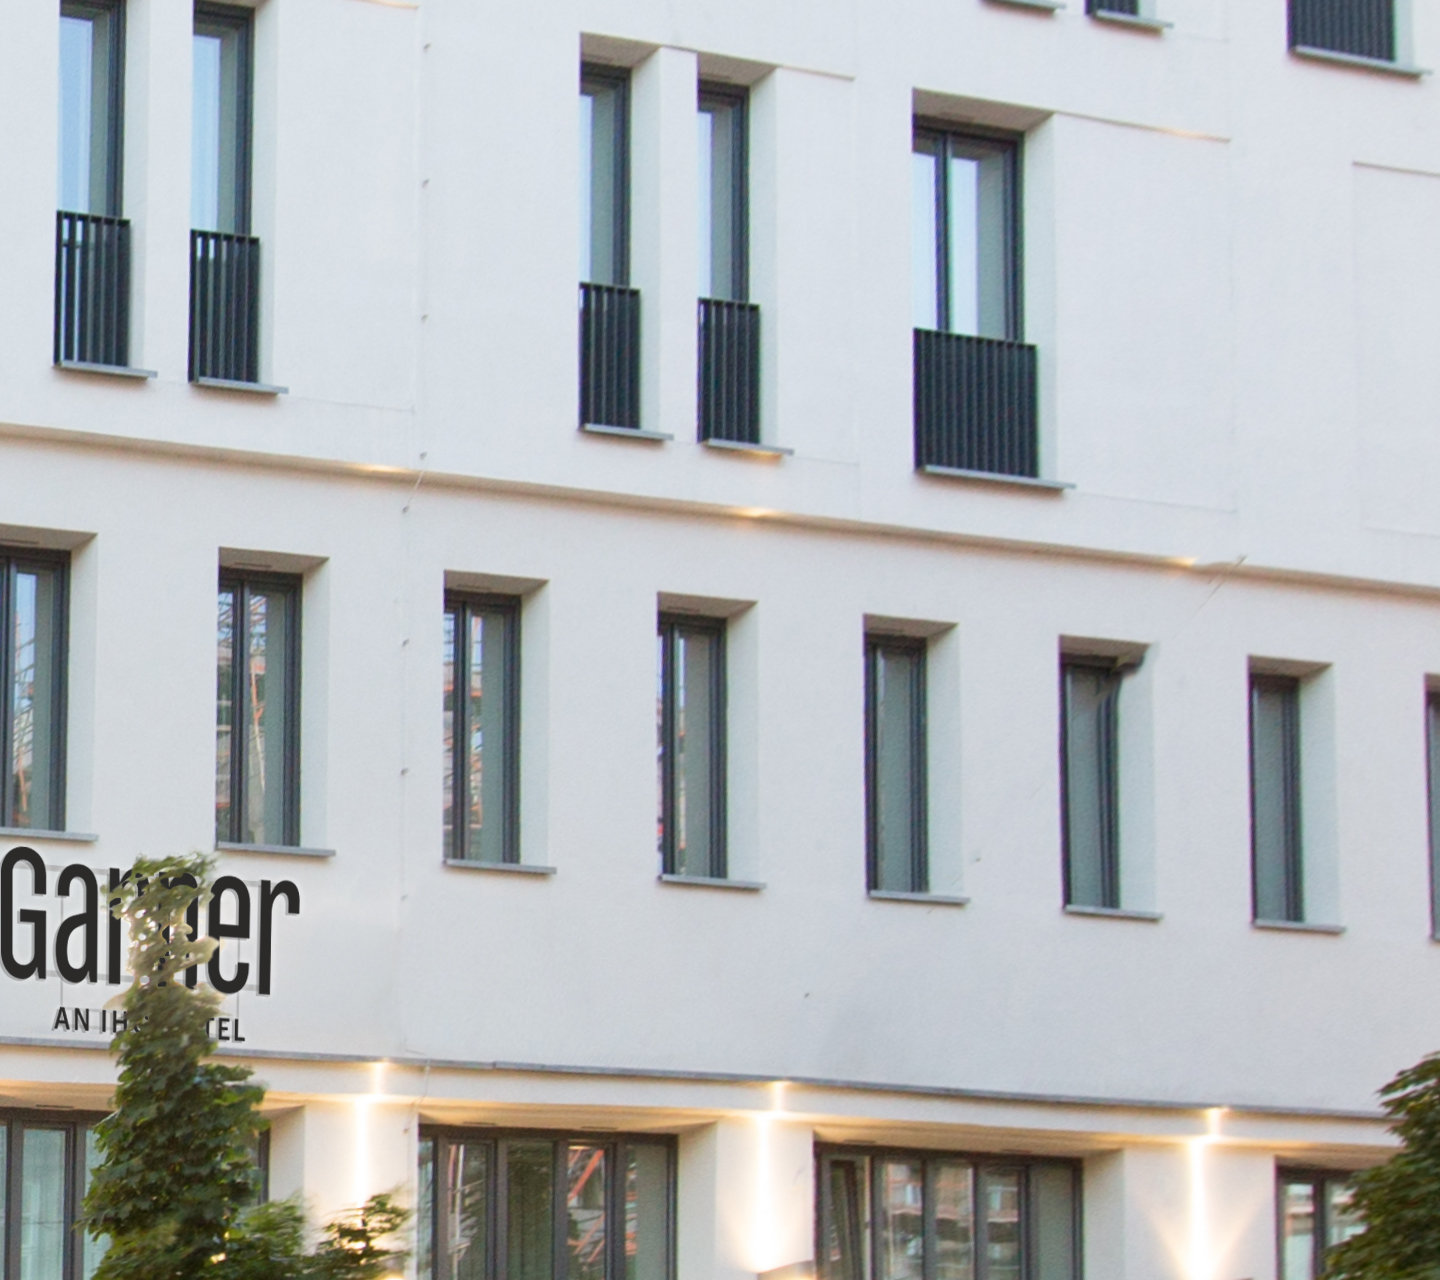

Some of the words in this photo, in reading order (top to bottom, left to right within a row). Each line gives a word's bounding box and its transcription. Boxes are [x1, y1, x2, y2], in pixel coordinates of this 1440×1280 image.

[0, 846, 300, 995] Garner
[54, 1006, 90, 1032] AN
[101, 1009, 140, 1034] IH
